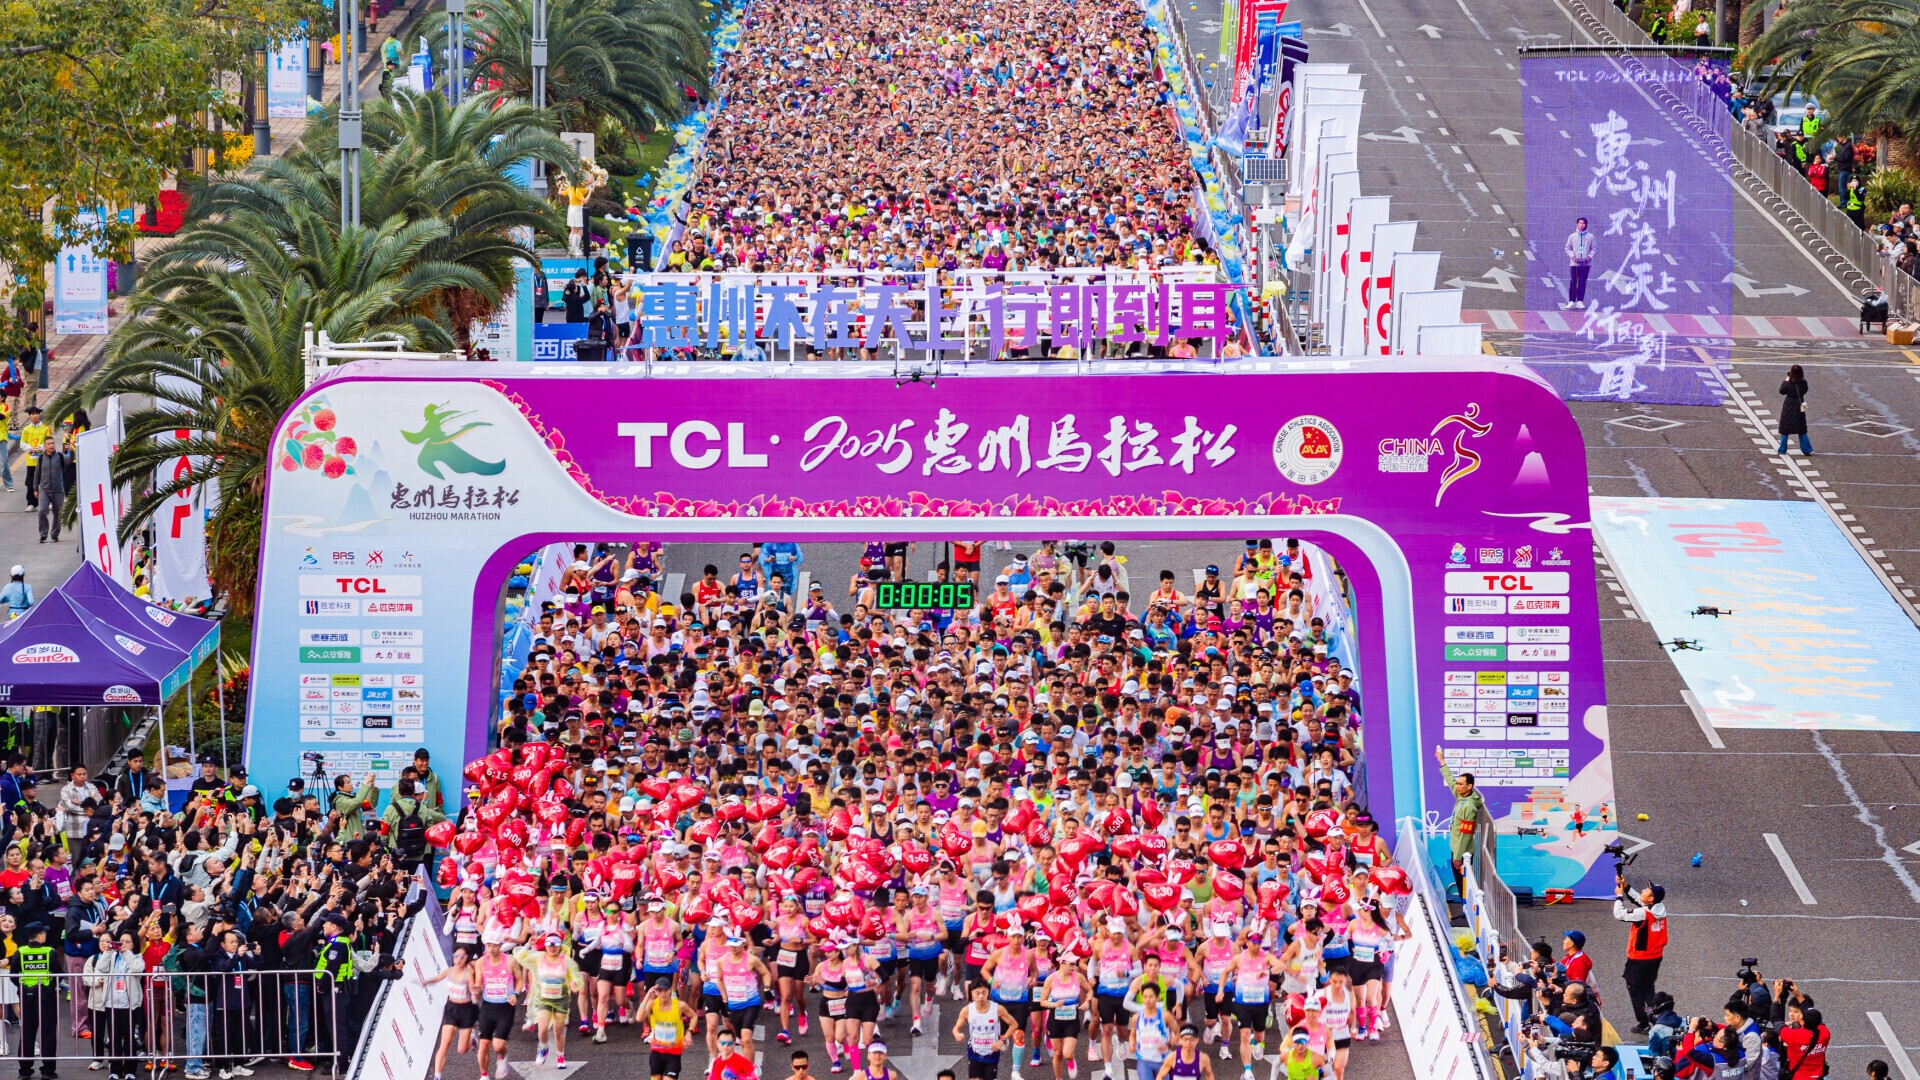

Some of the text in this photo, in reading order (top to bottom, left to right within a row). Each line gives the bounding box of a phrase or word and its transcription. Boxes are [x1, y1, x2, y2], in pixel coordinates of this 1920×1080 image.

[634, 281, 1256, 354] 惠州不在天上 行即到耳
[1276, 418, 1340, 453] CHINESE ATHLETICS ASSOCIATION
[1379, 438, 1444, 455] CHINA
[1668, 522, 1784, 558] TCL
[337, 578, 386, 593] TCL
[1483, 575, 1533, 590] TCL
[879, 584, 971, 607] 0:00:05
[380, 603, 413, 612] 匹克体育
[1526, 600, 1560, 609] 匹克体育
[311, 634, 349, 642] 德赛西威
[26, 646, 62, 654] 百岁山
[322, 651, 352, 659] 众安保险
[1467, 649, 1497, 657] 众安保险
[486, 768, 508, 781] 6:15
[513, 770, 532, 781] 3:00
[481, 808, 501, 820] 3:15
[1109, 816, 1124, 835] 4:30
[503, 828, 522, 846] 3:00
[948, 834, 968, 848] 2:15
[1146, 839, 1166, 848] 4:30
[1214, 843, 1236, 852] 4:30
[908, 852, 929, 863] 1:45
[856, 865, 878, 883] 2:15
[1151, 887, 1173, 897] 1:30
[1330, 880, 1346, 899] 5:00
[870, 914, 884, 936] 2:15
[1047, 915, 1069, 924] 4:00
